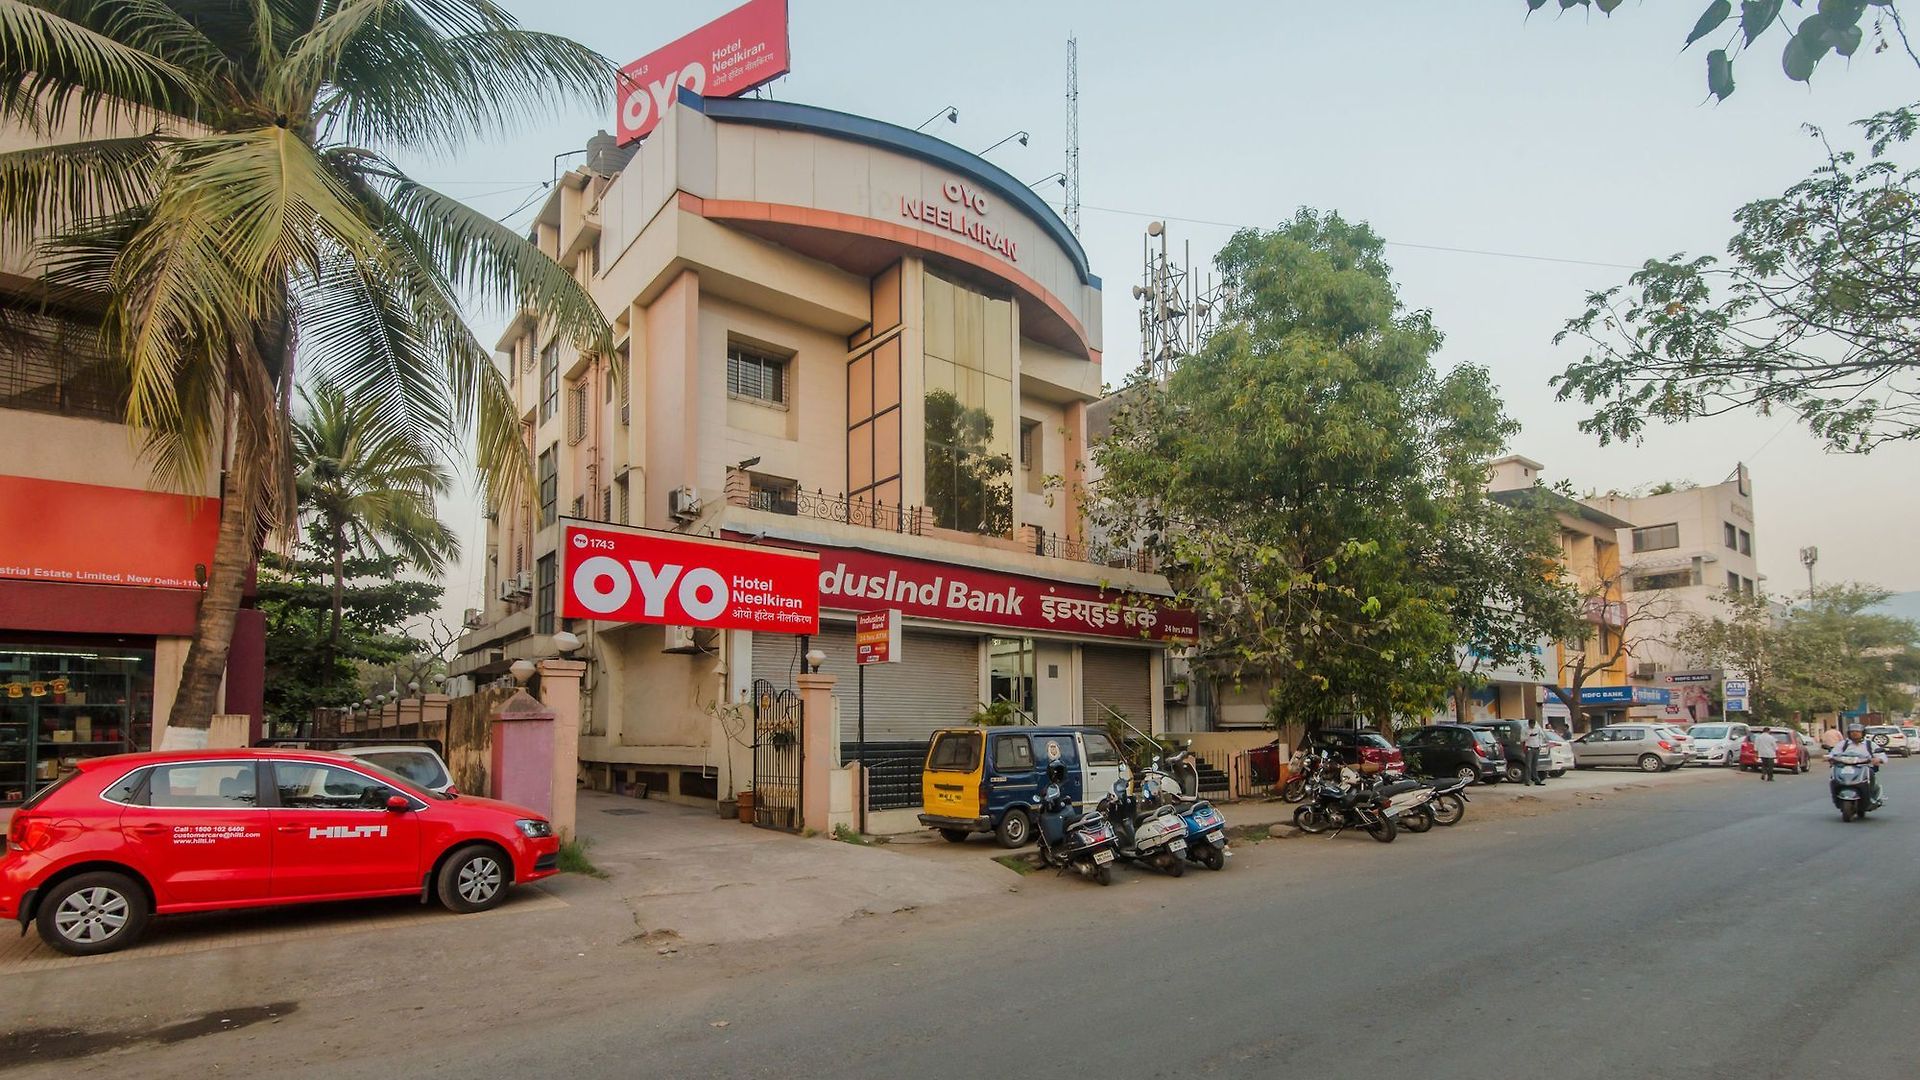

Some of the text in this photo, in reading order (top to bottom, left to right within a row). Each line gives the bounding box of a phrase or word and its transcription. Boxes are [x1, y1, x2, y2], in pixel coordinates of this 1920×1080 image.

[712, 38, 741, 62] Hotel
[712, 42, 765, 74] Neelkiran
[623, 62, 706, 131] OYO
[943, 179, 989, 216] OYO
[901, 195, 1018, 262] NEELKIRAN
[590, 538, 615, 550] 1743
[34, 568, 72, 578] Estate
[76, 571, 123, 582] Limited,
[127, 574, 151, 583] New
[733, 575, 773, 591] Hotel
[573, 556, 729, 621] OYO
[947, 581, 1025, 616] Bank
[733, 590, 803, 609] Neelkiran
[732, 606, 752, 619] ओयो
[777, 610, 812, 624] नीलकिरण
[1164, 624, 1172, 632] 24
[1181, 626, 1193, 635] ATM
[309, 825, 388, 839] HILTI
